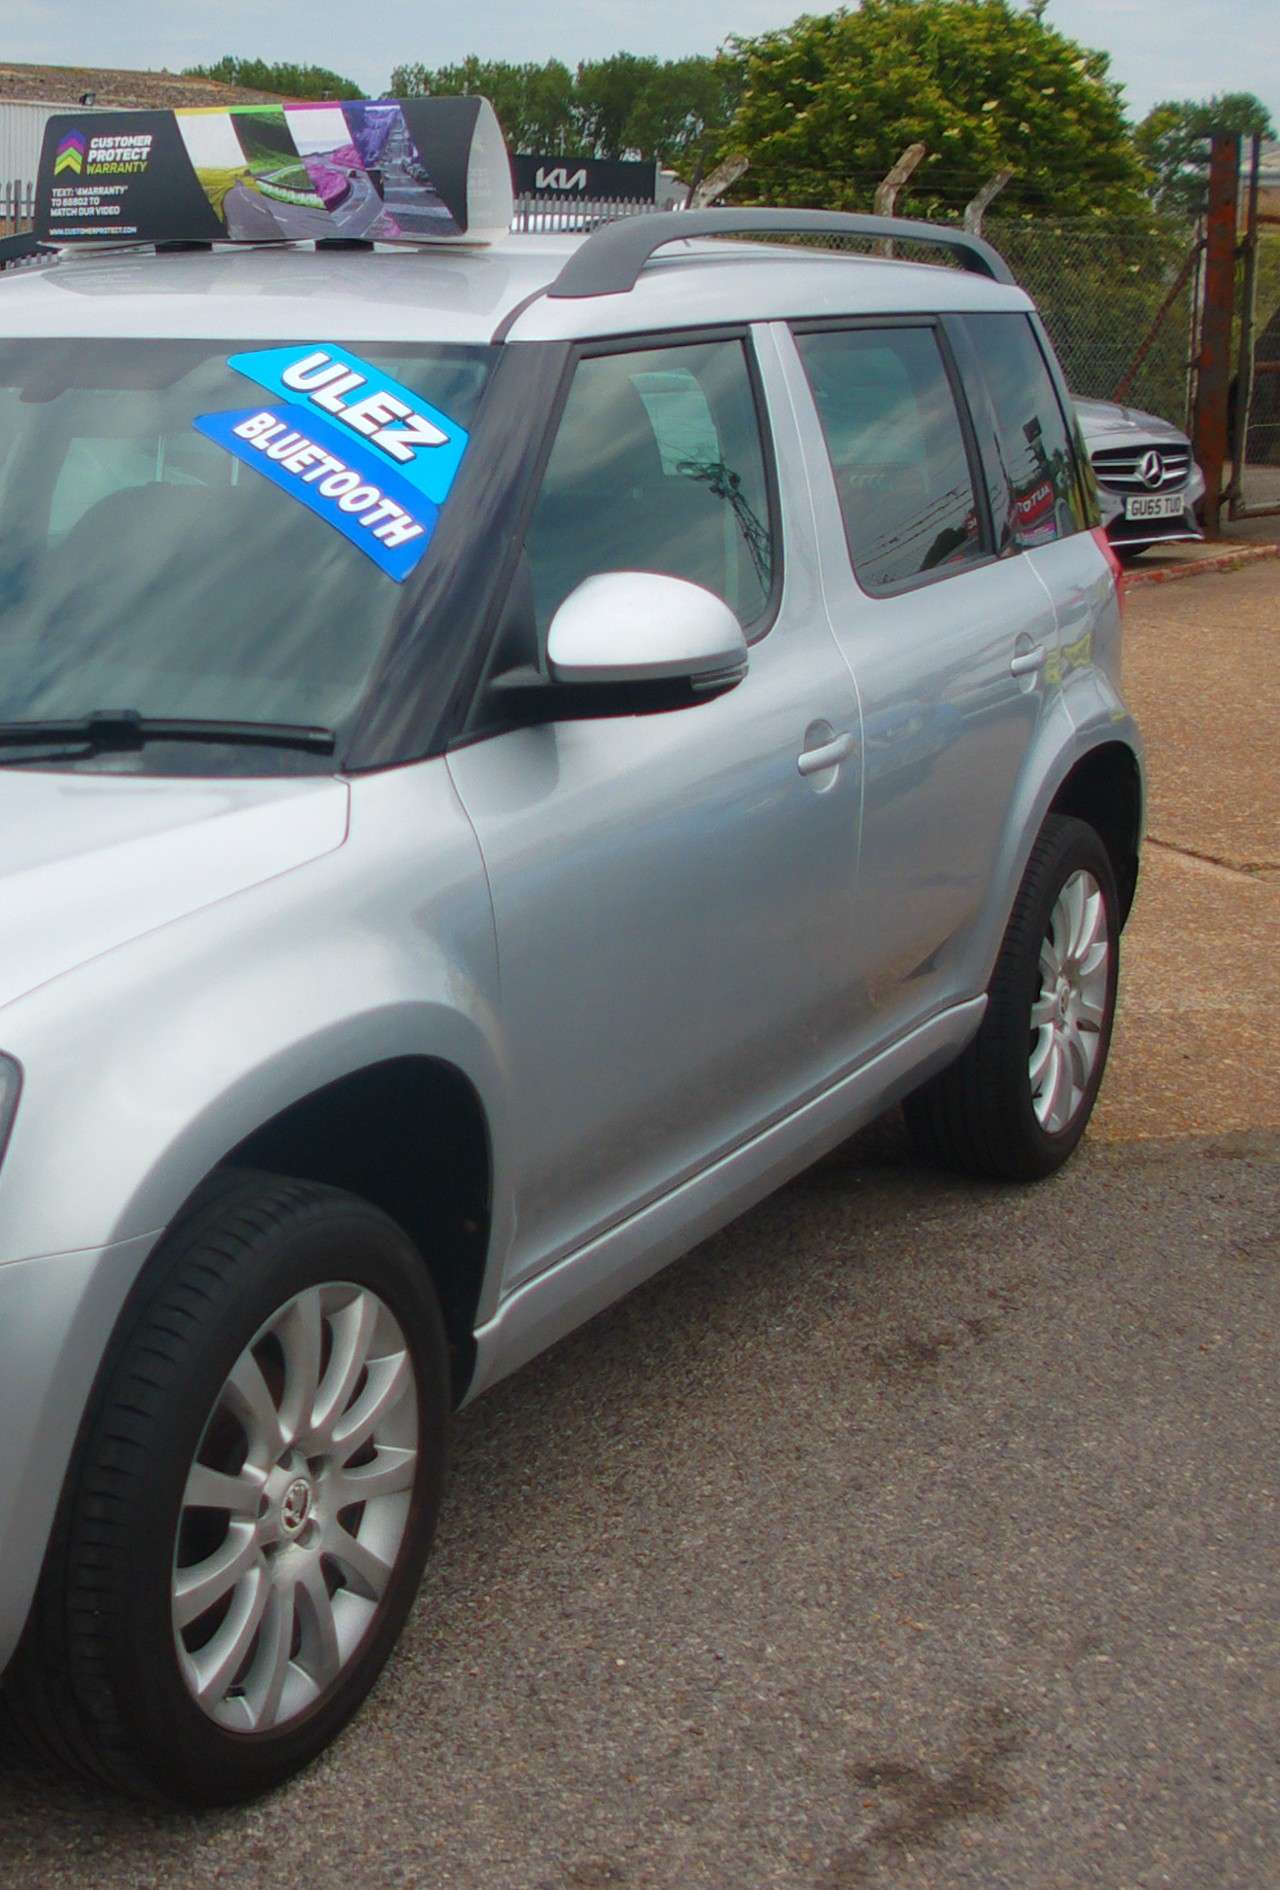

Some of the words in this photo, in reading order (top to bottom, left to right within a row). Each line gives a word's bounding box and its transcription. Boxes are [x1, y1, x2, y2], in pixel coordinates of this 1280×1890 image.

[91, 136, 152, 148] CUSTOMER
[88, 148, 151, 162] PROTECT
[86, 162, 148, 174] WARRANTY
[96, 205, 121, 215] VIDEO
[280, 351, 452, 464] ULEZ
[232, 411, 425, 548] BLUETOOTH
